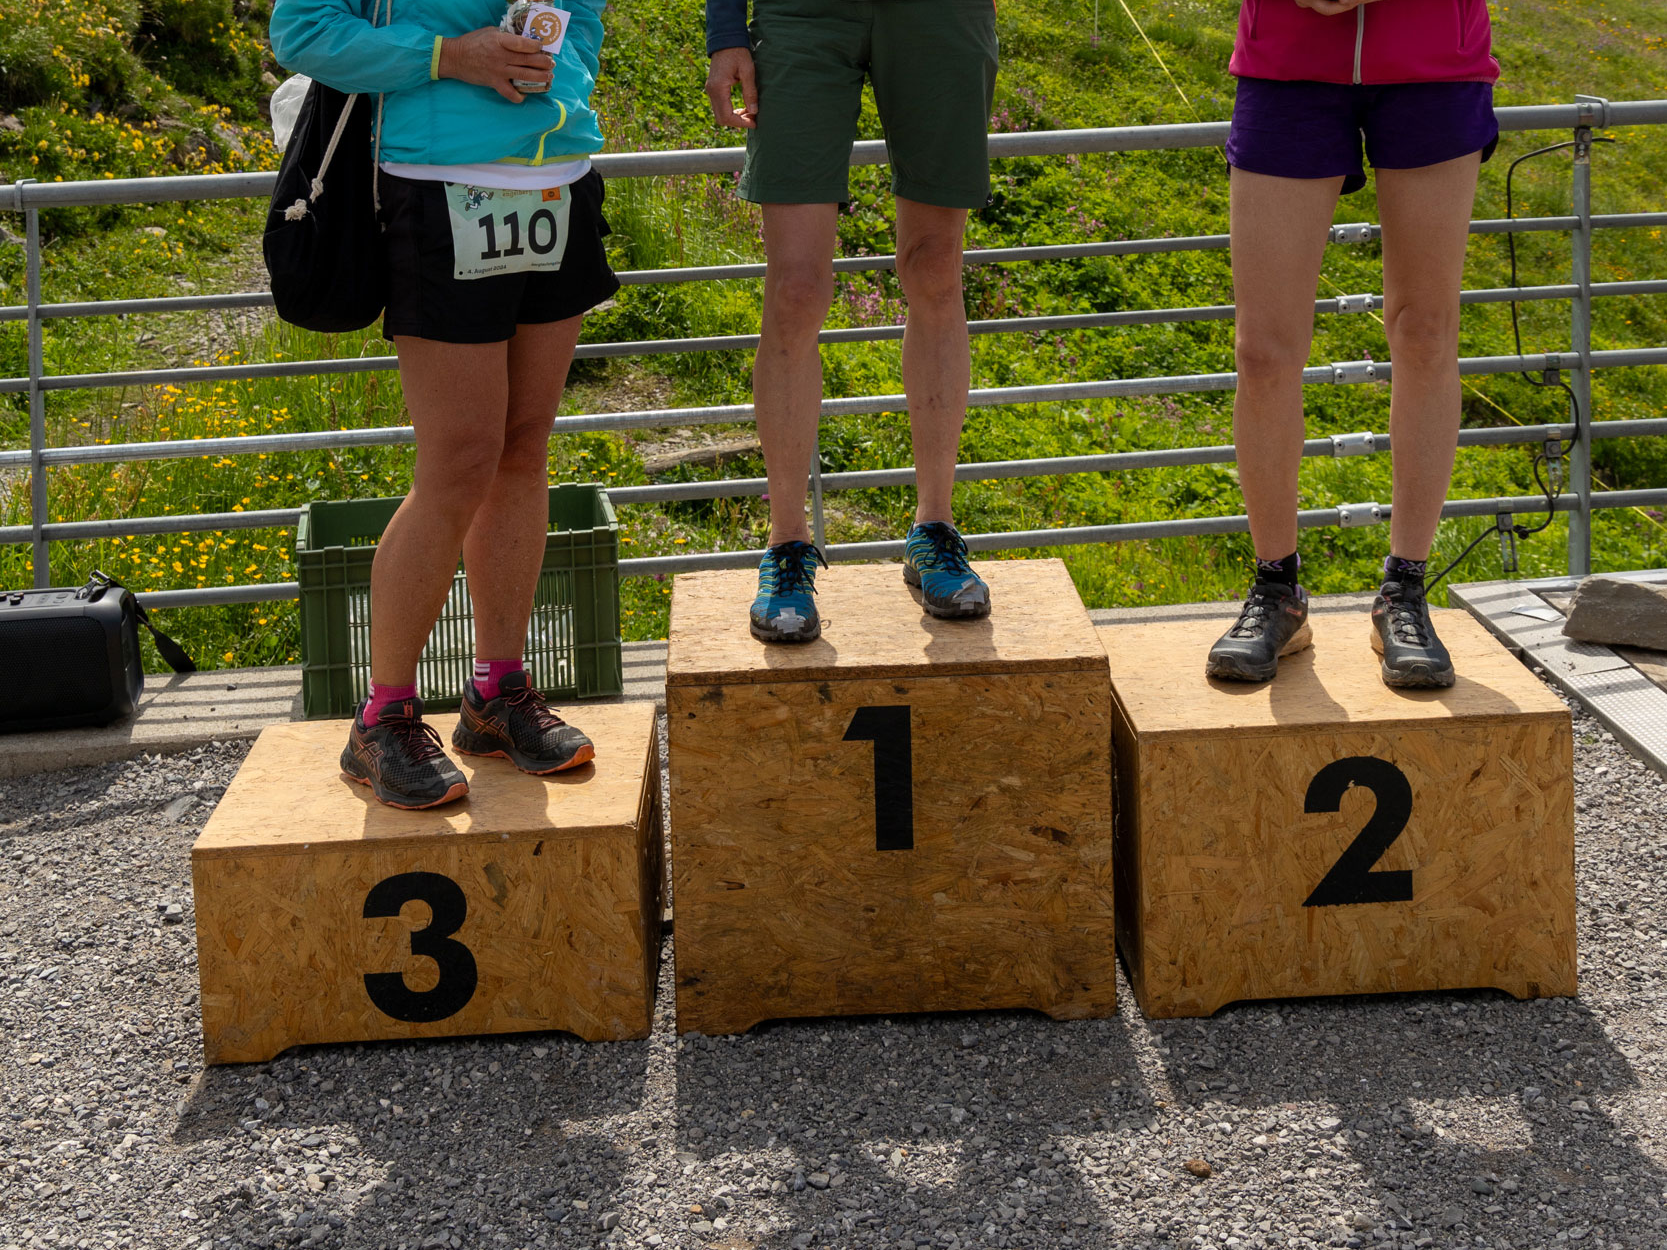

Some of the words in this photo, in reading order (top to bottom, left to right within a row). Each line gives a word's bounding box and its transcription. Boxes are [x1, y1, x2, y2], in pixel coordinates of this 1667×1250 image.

[539, 20, 554, 36] 3
[478, 208, 557, 260] 110
[842, 705, 914, 851] 1
[1302, 756, 1413, 907] 2
[363, 871, 478, 1023] 3
